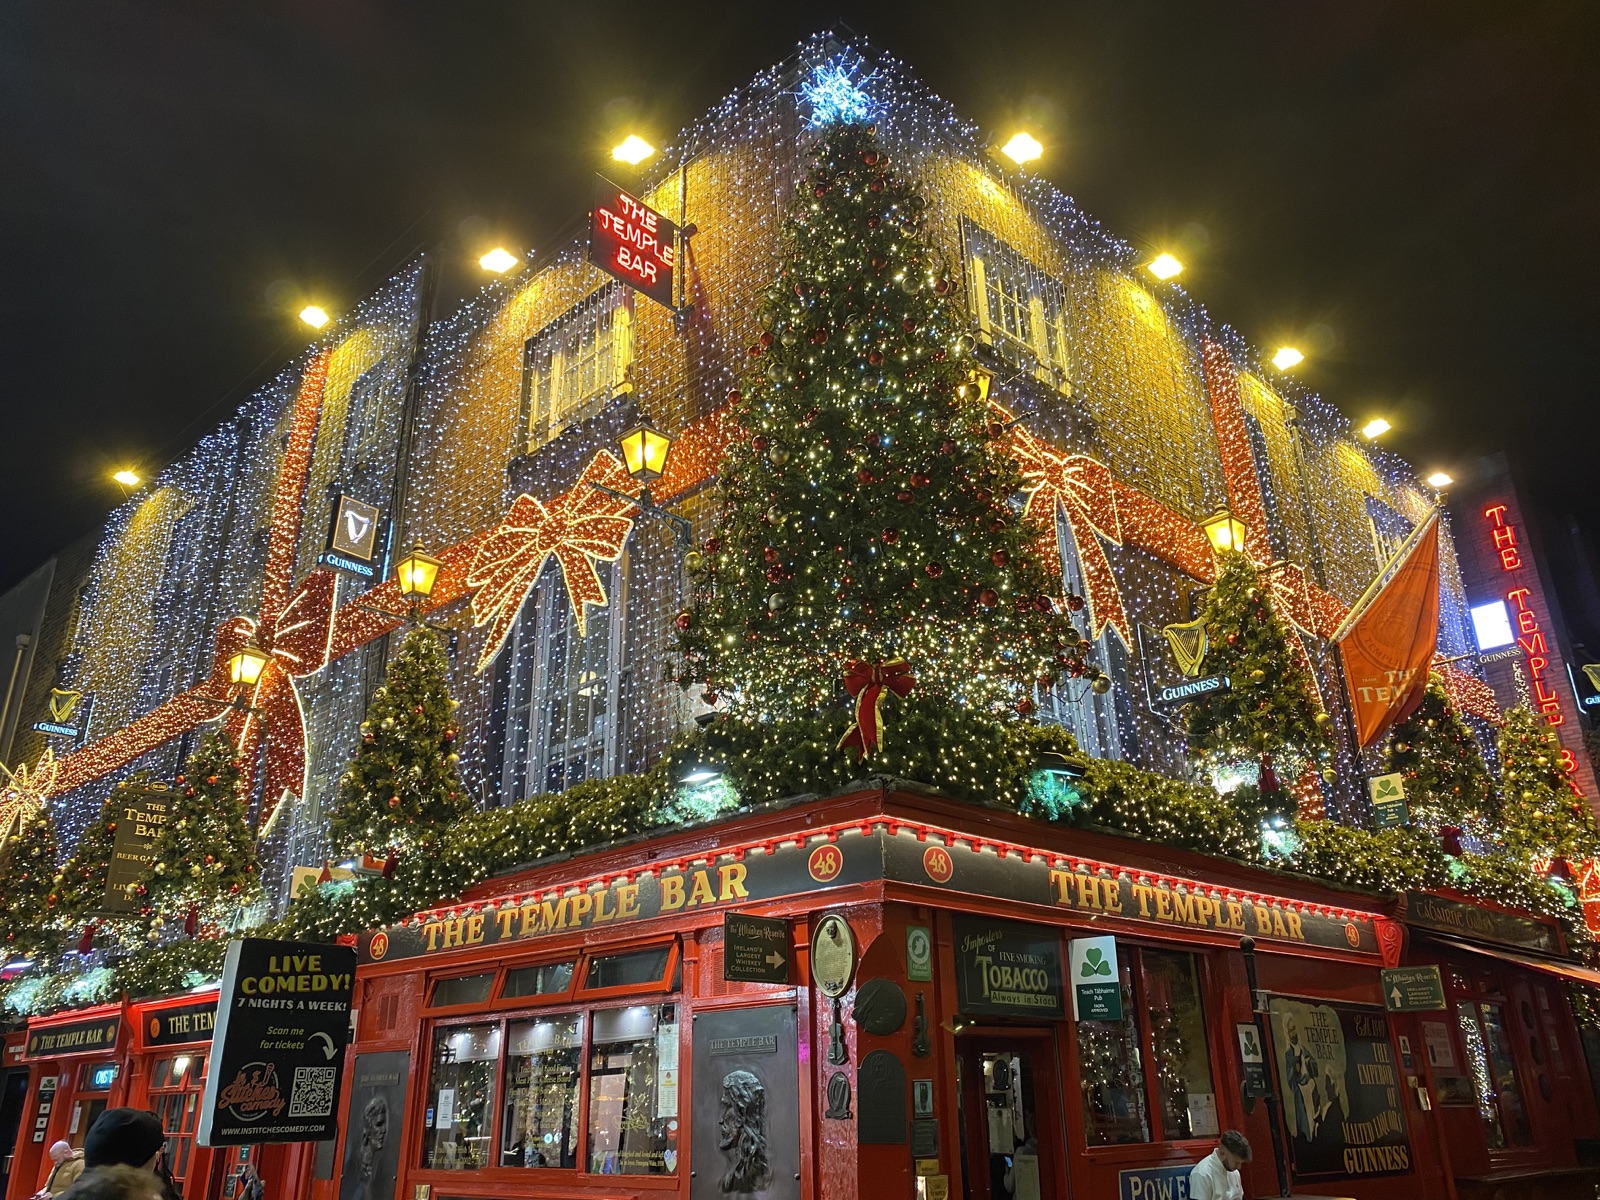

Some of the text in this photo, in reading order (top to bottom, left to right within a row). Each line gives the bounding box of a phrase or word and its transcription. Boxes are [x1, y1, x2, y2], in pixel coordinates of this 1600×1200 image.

[620, 194, 657, 233] THE
[600, 209, 674, 267] TEMPLE
[618, 247, 657, 283] BAR
[1486, 505, 1522, 570] THE
[327, 554, 374, 576] GUINNESS
[1480, 649, 1521, 663] GUINNESS
[1508, 588, 1564, 726] TEMPLE
[1163, 677, 1220, 700] GUINNESS
[39, 722, 78, 736] GUINNESS
[146, 802, 166, 811] THE
[116, 852, 138, 861] BEER
[814, 851, 837, 876] 48
[928, 852, 947, 875] 48
[424, 863, 749, 950] THE TEMPLE BAR
[1050, 870, 1304, 939] THE TEMPLE BAR
[961, 929, 1002, 954] Importers
[1347, 926, 1358, 943] 48
[373, 937, 386, 956] 48
[988, 944, 996, 952] OF
[269, 955, 322, 973] LIVE
[999, 951, 1046, 965] FINE SMOKING
[731, 965, 765, 973] COLLECTION
[974, 955, 1049, 998] TOBACCO
[241, 974, 350, 995] COMEDY!
[237, 998, 245, 1008] 7
[248, 999, 294, 1009] NIGHTS
[308, 1001, 347, 1012] WEEK!
[992, 992, 1057, 1006] Always in Stock
[168, 1015, 189, 1035] THE
[1310, 1011, 1329, 1028] THE
[40, 1028, 103, 1049] THE TEMPLE BAR
[267, 1026, 304, 1036] Scan me
[1304, 1027, 1339, 1045] TEMPLE
[259, 1039, 304, 1050] for tickets
[710, 1036, 775, 1050] THE TEMPLE BAR
[1316, 1043, 1335, 1061] BAR
[1372, 1043, 1390, 1063] THE
[1357, 1064, 1394, 1085] EMPEROR
[1386, 1087, 1397, 1108] OF
[221, 1124, 325, 1136] WWW.INSTITCHESCOMEDY.COM
[1341, 1120, 1376, 1145] MALTED
[1343, 1145, 1409, 1174] GUINNESS
[1129, 1175, 1190, 1200] POWE
